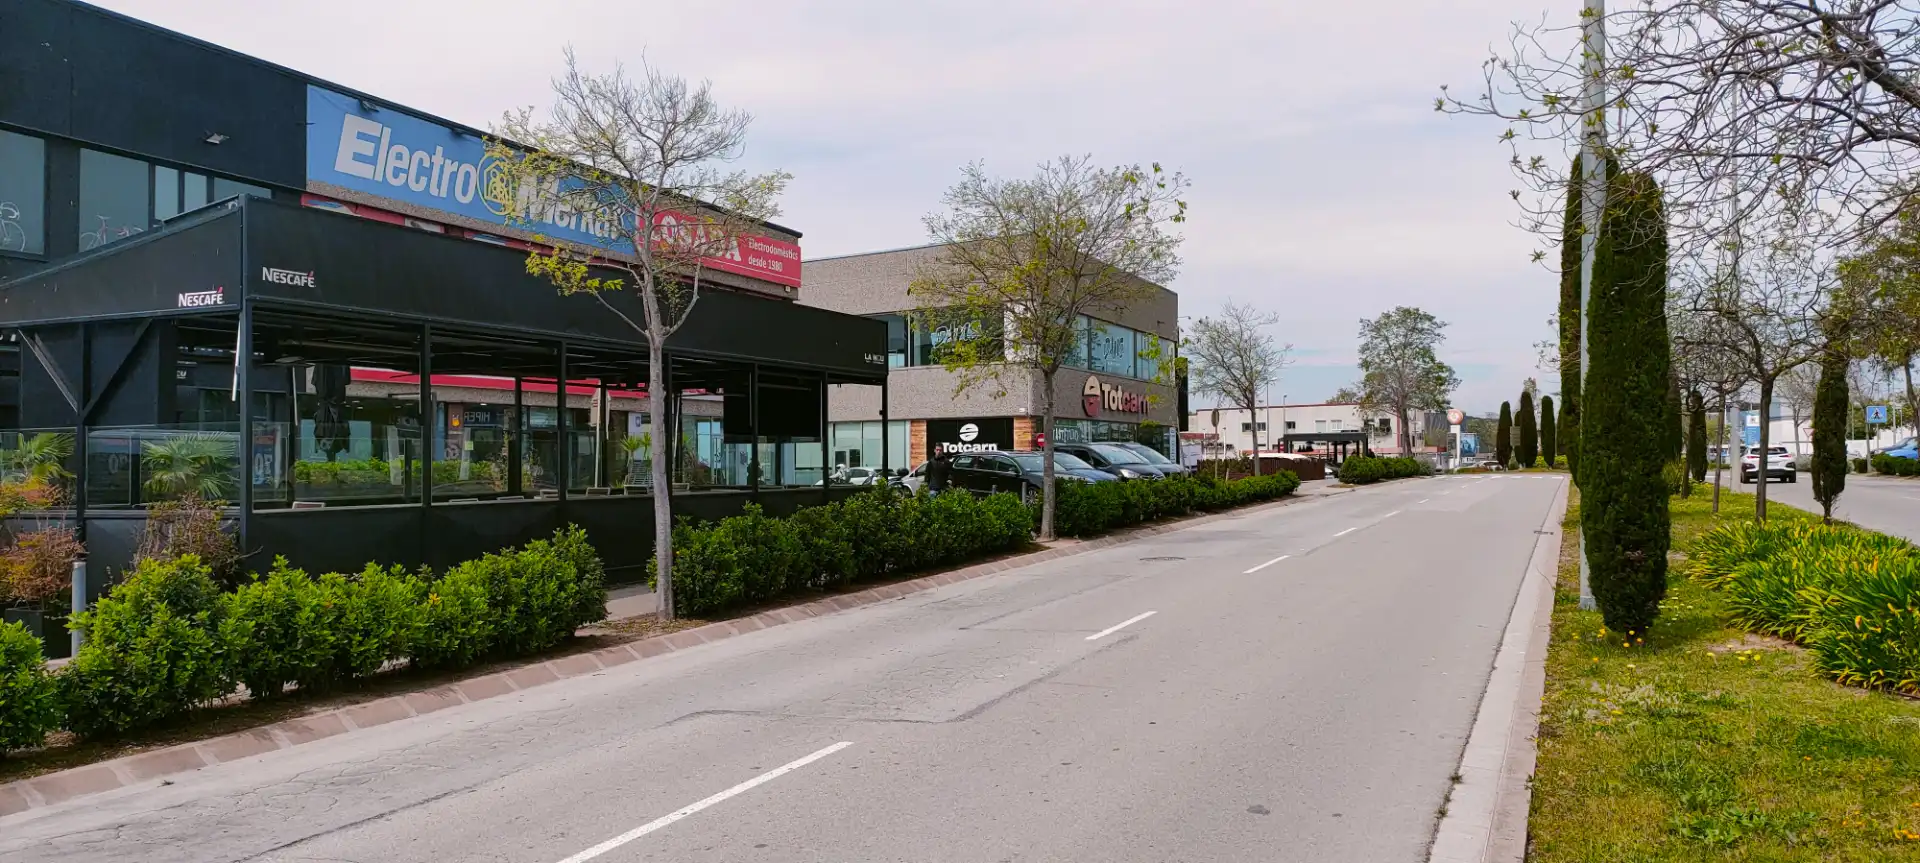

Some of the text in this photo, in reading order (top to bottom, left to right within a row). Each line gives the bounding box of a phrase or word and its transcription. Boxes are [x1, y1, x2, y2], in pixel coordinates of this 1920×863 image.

[335, 113, 477, 204] Electro
[748, 255, 783, 272] desde 1980
[1102, 382, 1150, 413] Totcarn
[942, 442, 998, 454] Totcarn
